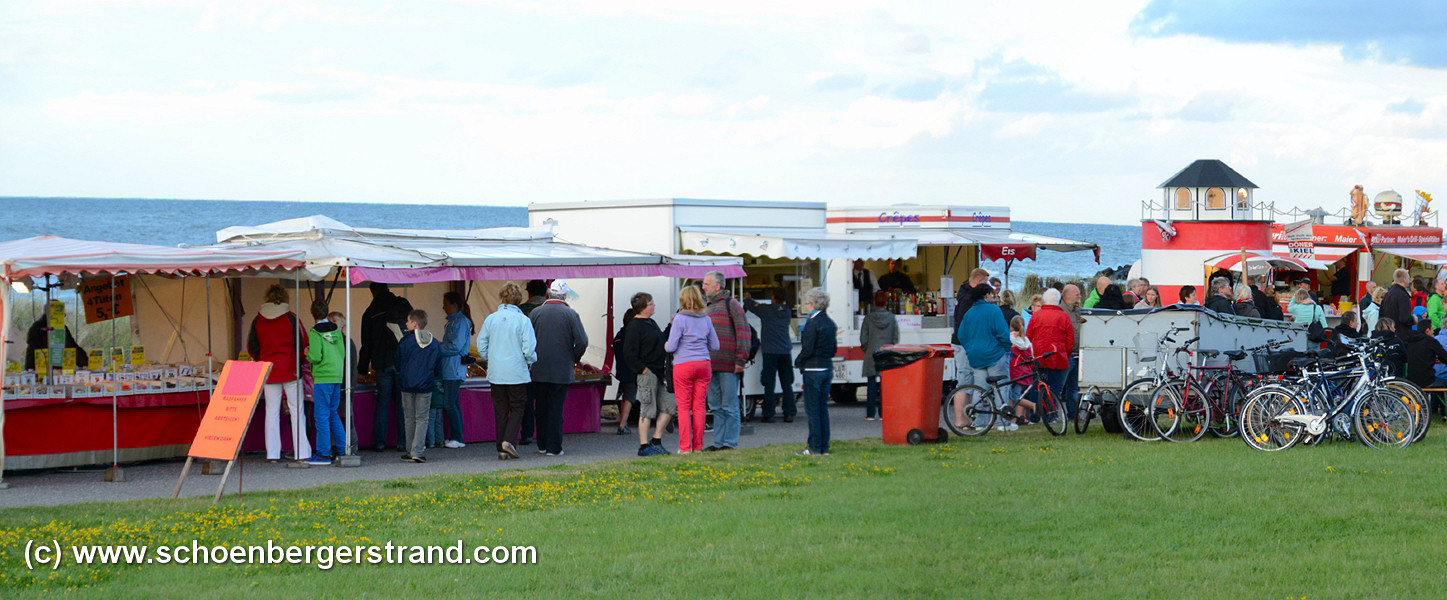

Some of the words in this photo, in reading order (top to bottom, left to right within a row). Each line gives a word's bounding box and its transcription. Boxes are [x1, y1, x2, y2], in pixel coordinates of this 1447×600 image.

[878, 211, 920, 225] Crêpes
[972, 212, 991, 225] Crêpes
[84, 279, 125, 294] Angebot
